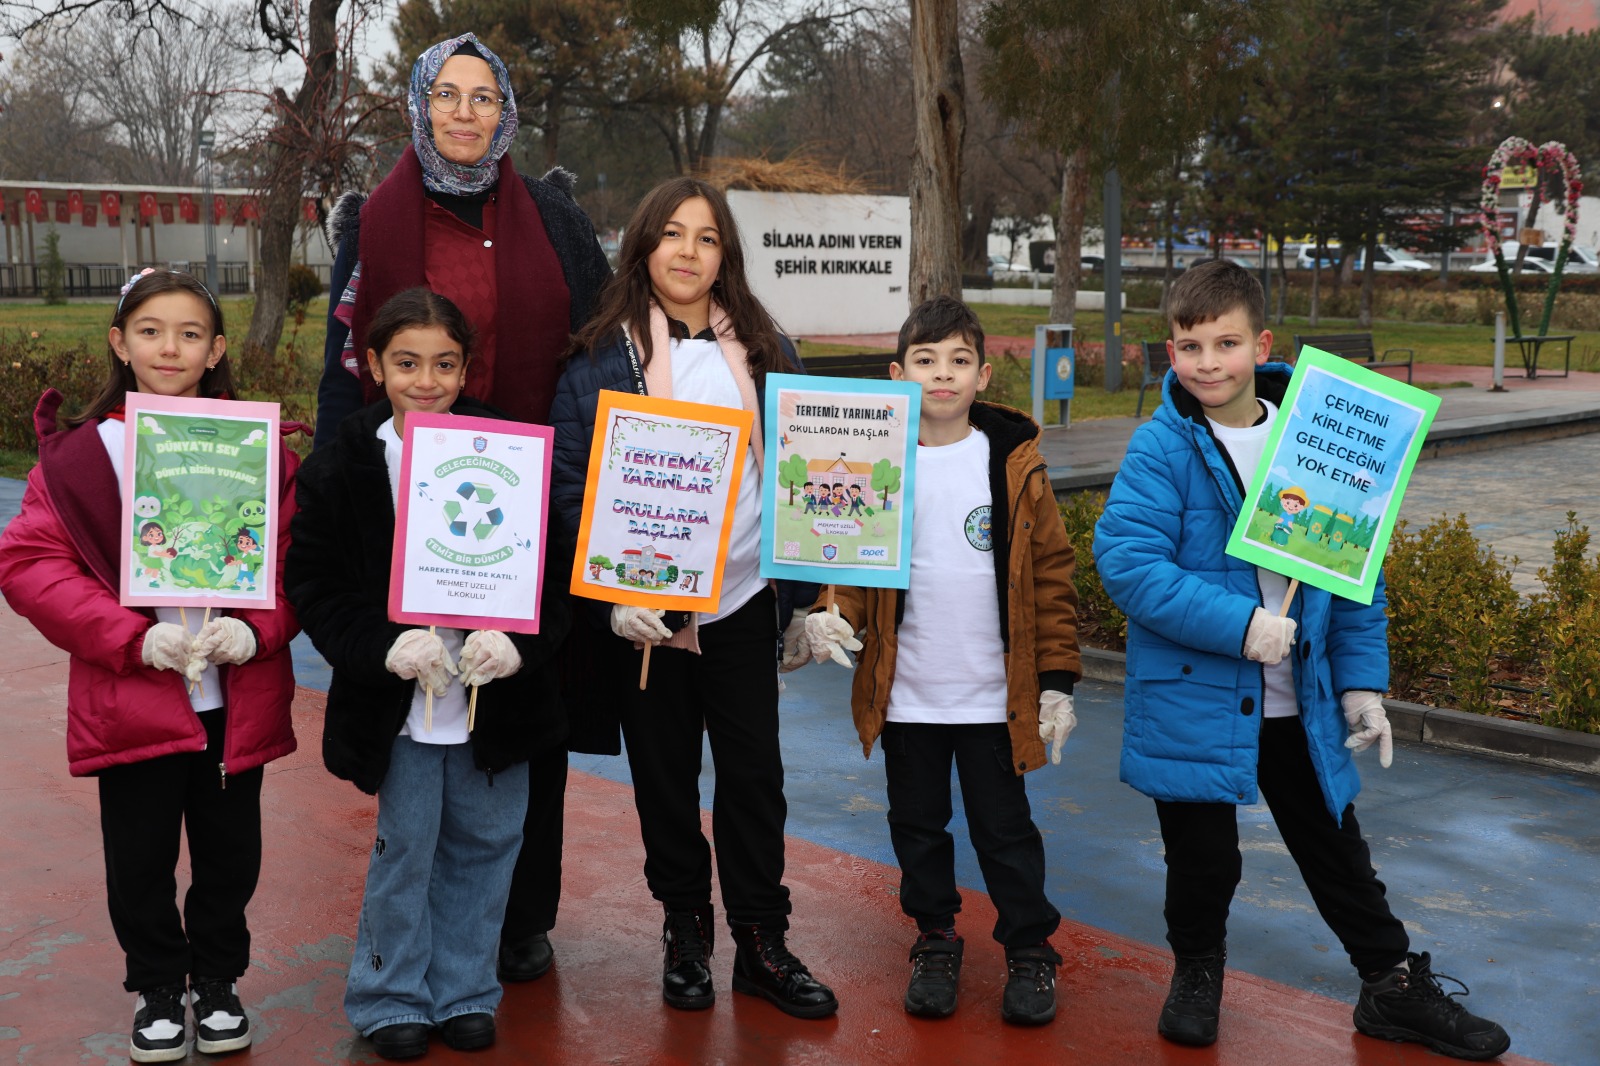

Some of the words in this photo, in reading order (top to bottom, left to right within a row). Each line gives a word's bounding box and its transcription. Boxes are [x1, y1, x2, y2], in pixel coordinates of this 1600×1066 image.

[763, 229, 814, 248] SİLAHA
[818, 234, 855, 248] ADINI
[859, 235, 902, 249] VEREN
[775, 256, 817, 278] ŞEHİR
[821, 260, 892, 274] KIRIKKALE
[796, 405, 839, 418] TERTEMİZ
[843, 408, 888, 420] YARINLAR
[1325, 394, 1390, 428] ÇEVRENİ
[789, 425, 849, 435] OKULLARDAN
[853, 429, 889, 440] BAŞLAR
[1312, 413, 1386, 451] KİRLETME
[155, 440, 214, 454] DÜNYA'YI
[216, 443, 240, 456] SEV
[1296, 432, 1386, 474] GELECEĞİNİ
[624, 445, 714, 473] TERTEMİZ
[155, 467, 188, 479] DÜNYA
[190, 464, 215, 474] BİZİM
[218, 468, 258, 485] YUVAMIZ
[436, 456, 499, 476] GELECEĞİMİZ
[500, 467, 518, 485] İÇİN
[621, 466, 713, 494] YARINLAR
[1296, 454, 1328, 476] YOK
[1331, 468, 1371, 493] ETME
[612, 499, 710, 525] OKULLARDA
[967, 508, 992, 524] PARILT
[628, 520, 692, 541] BAŞLAR
[427, 539, 454, 559] TEMİZ
[456, 554, 471, 564] BİR
[474, 552, 507, 564] DÜNYA
[418, 566, 459, 574] HAREKETE
[437, 579, 468, 588] MEHMET
[448, 590, 486, 600] İLKOKULU
